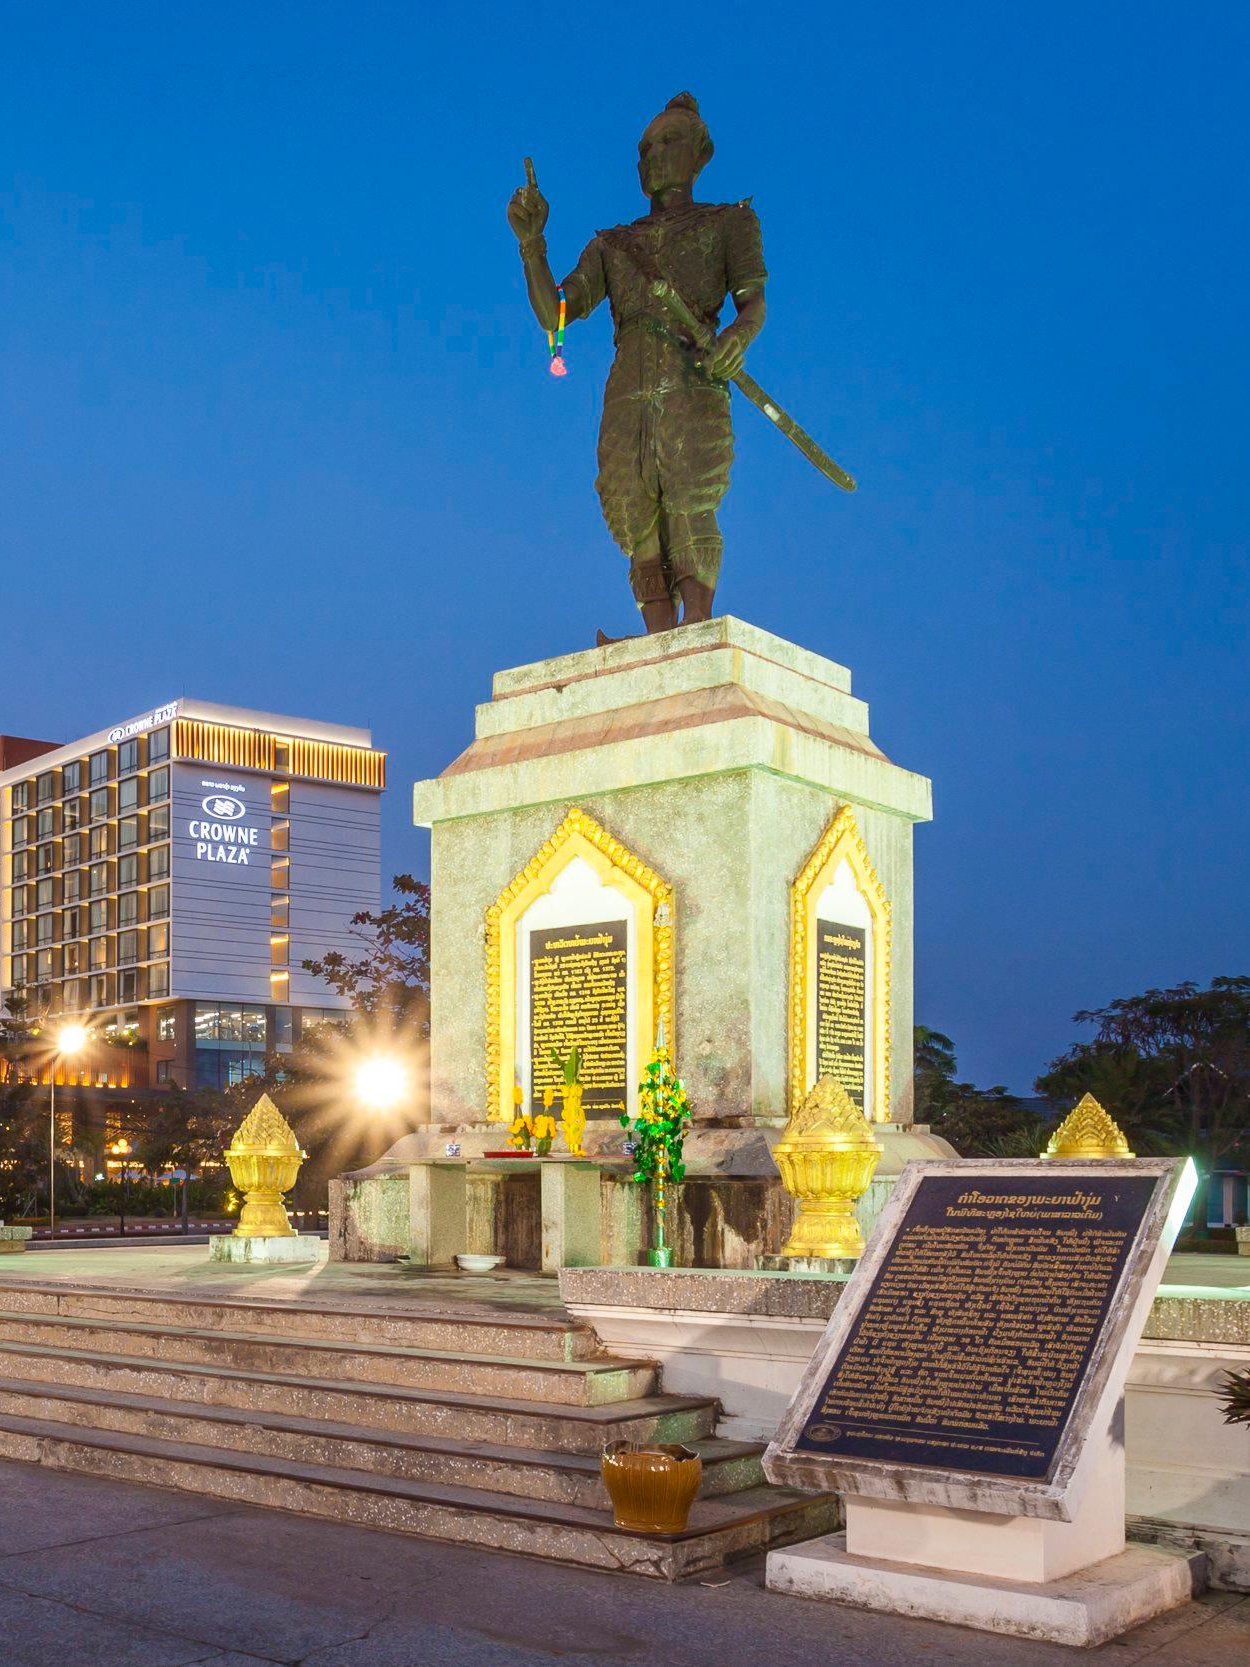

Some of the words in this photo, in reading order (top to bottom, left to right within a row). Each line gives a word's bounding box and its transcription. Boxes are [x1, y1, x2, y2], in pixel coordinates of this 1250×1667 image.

[126, 715, 154, 736] CROWNE
[189, 820, 258, 846] CROWNE
[197, 841, 250, 865] PLAZA
